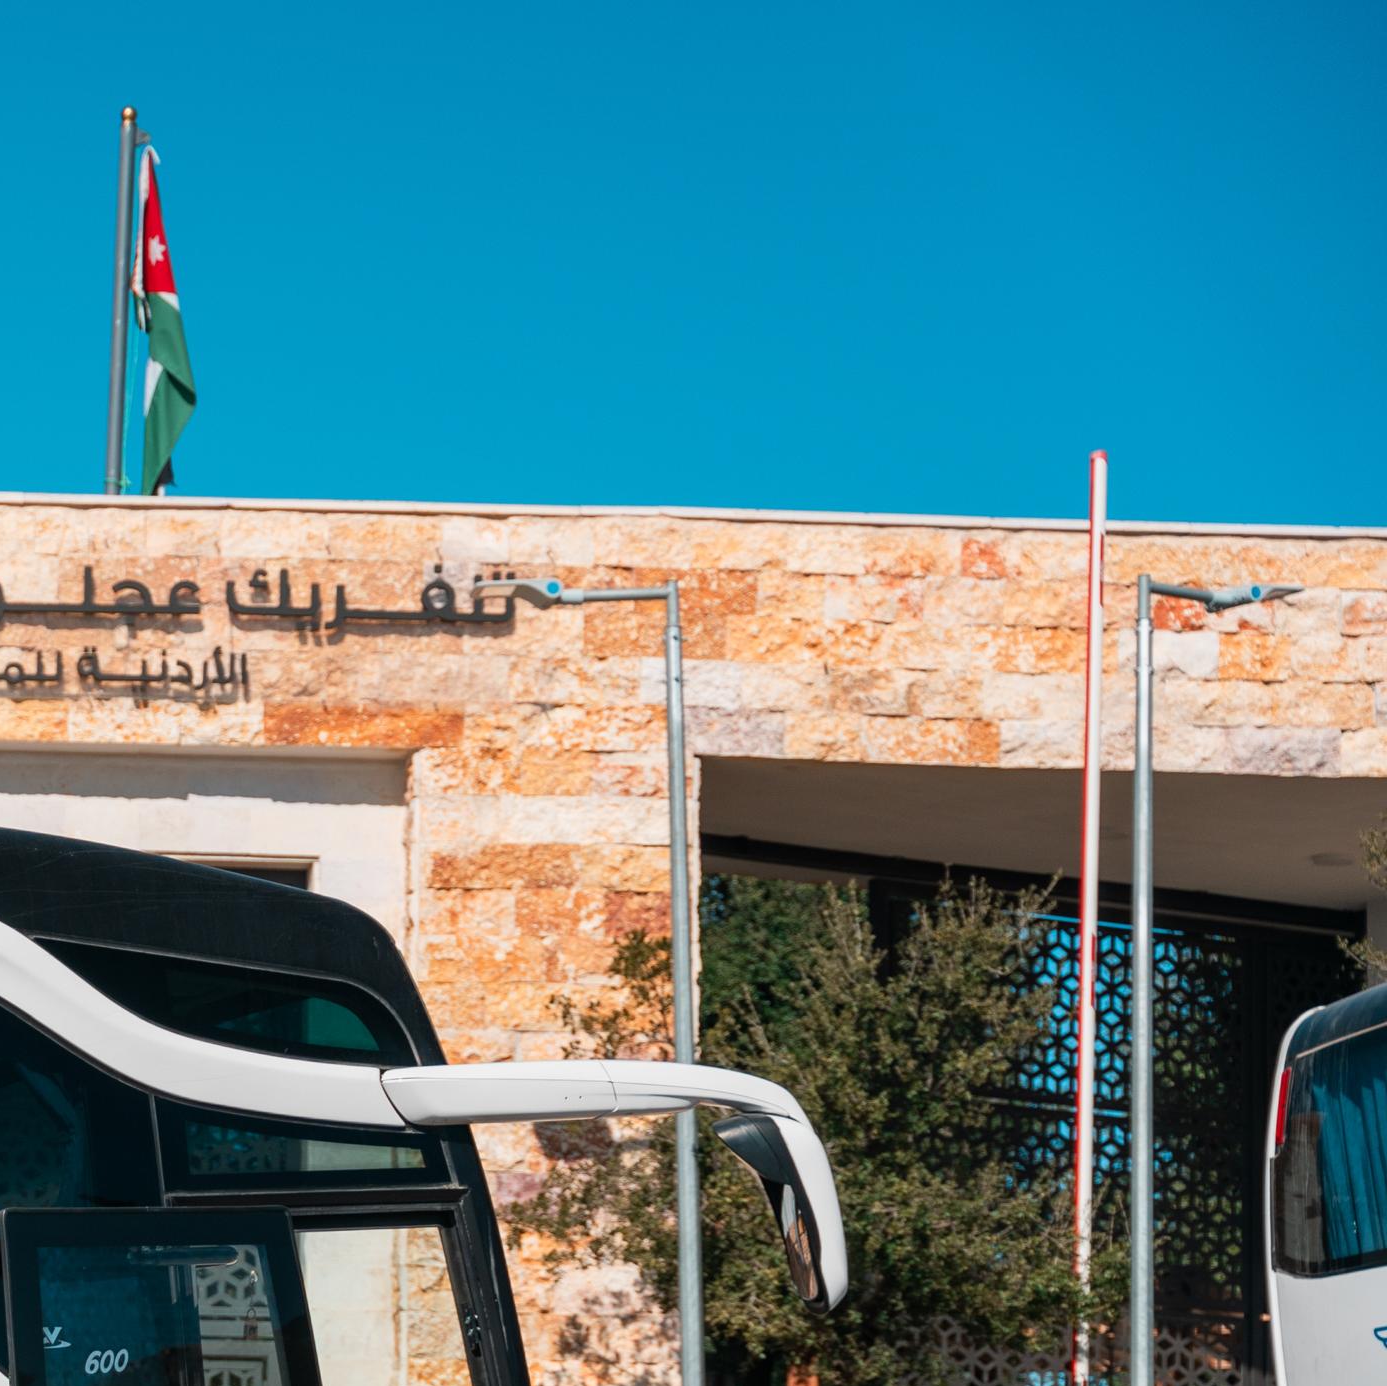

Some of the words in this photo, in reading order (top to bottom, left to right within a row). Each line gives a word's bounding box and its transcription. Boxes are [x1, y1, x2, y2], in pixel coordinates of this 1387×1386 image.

[226, 563, 515, 631] تلفريك
[76, 644, 248, 694] الأردنية
[84, 1348, 129, 1375] 600
